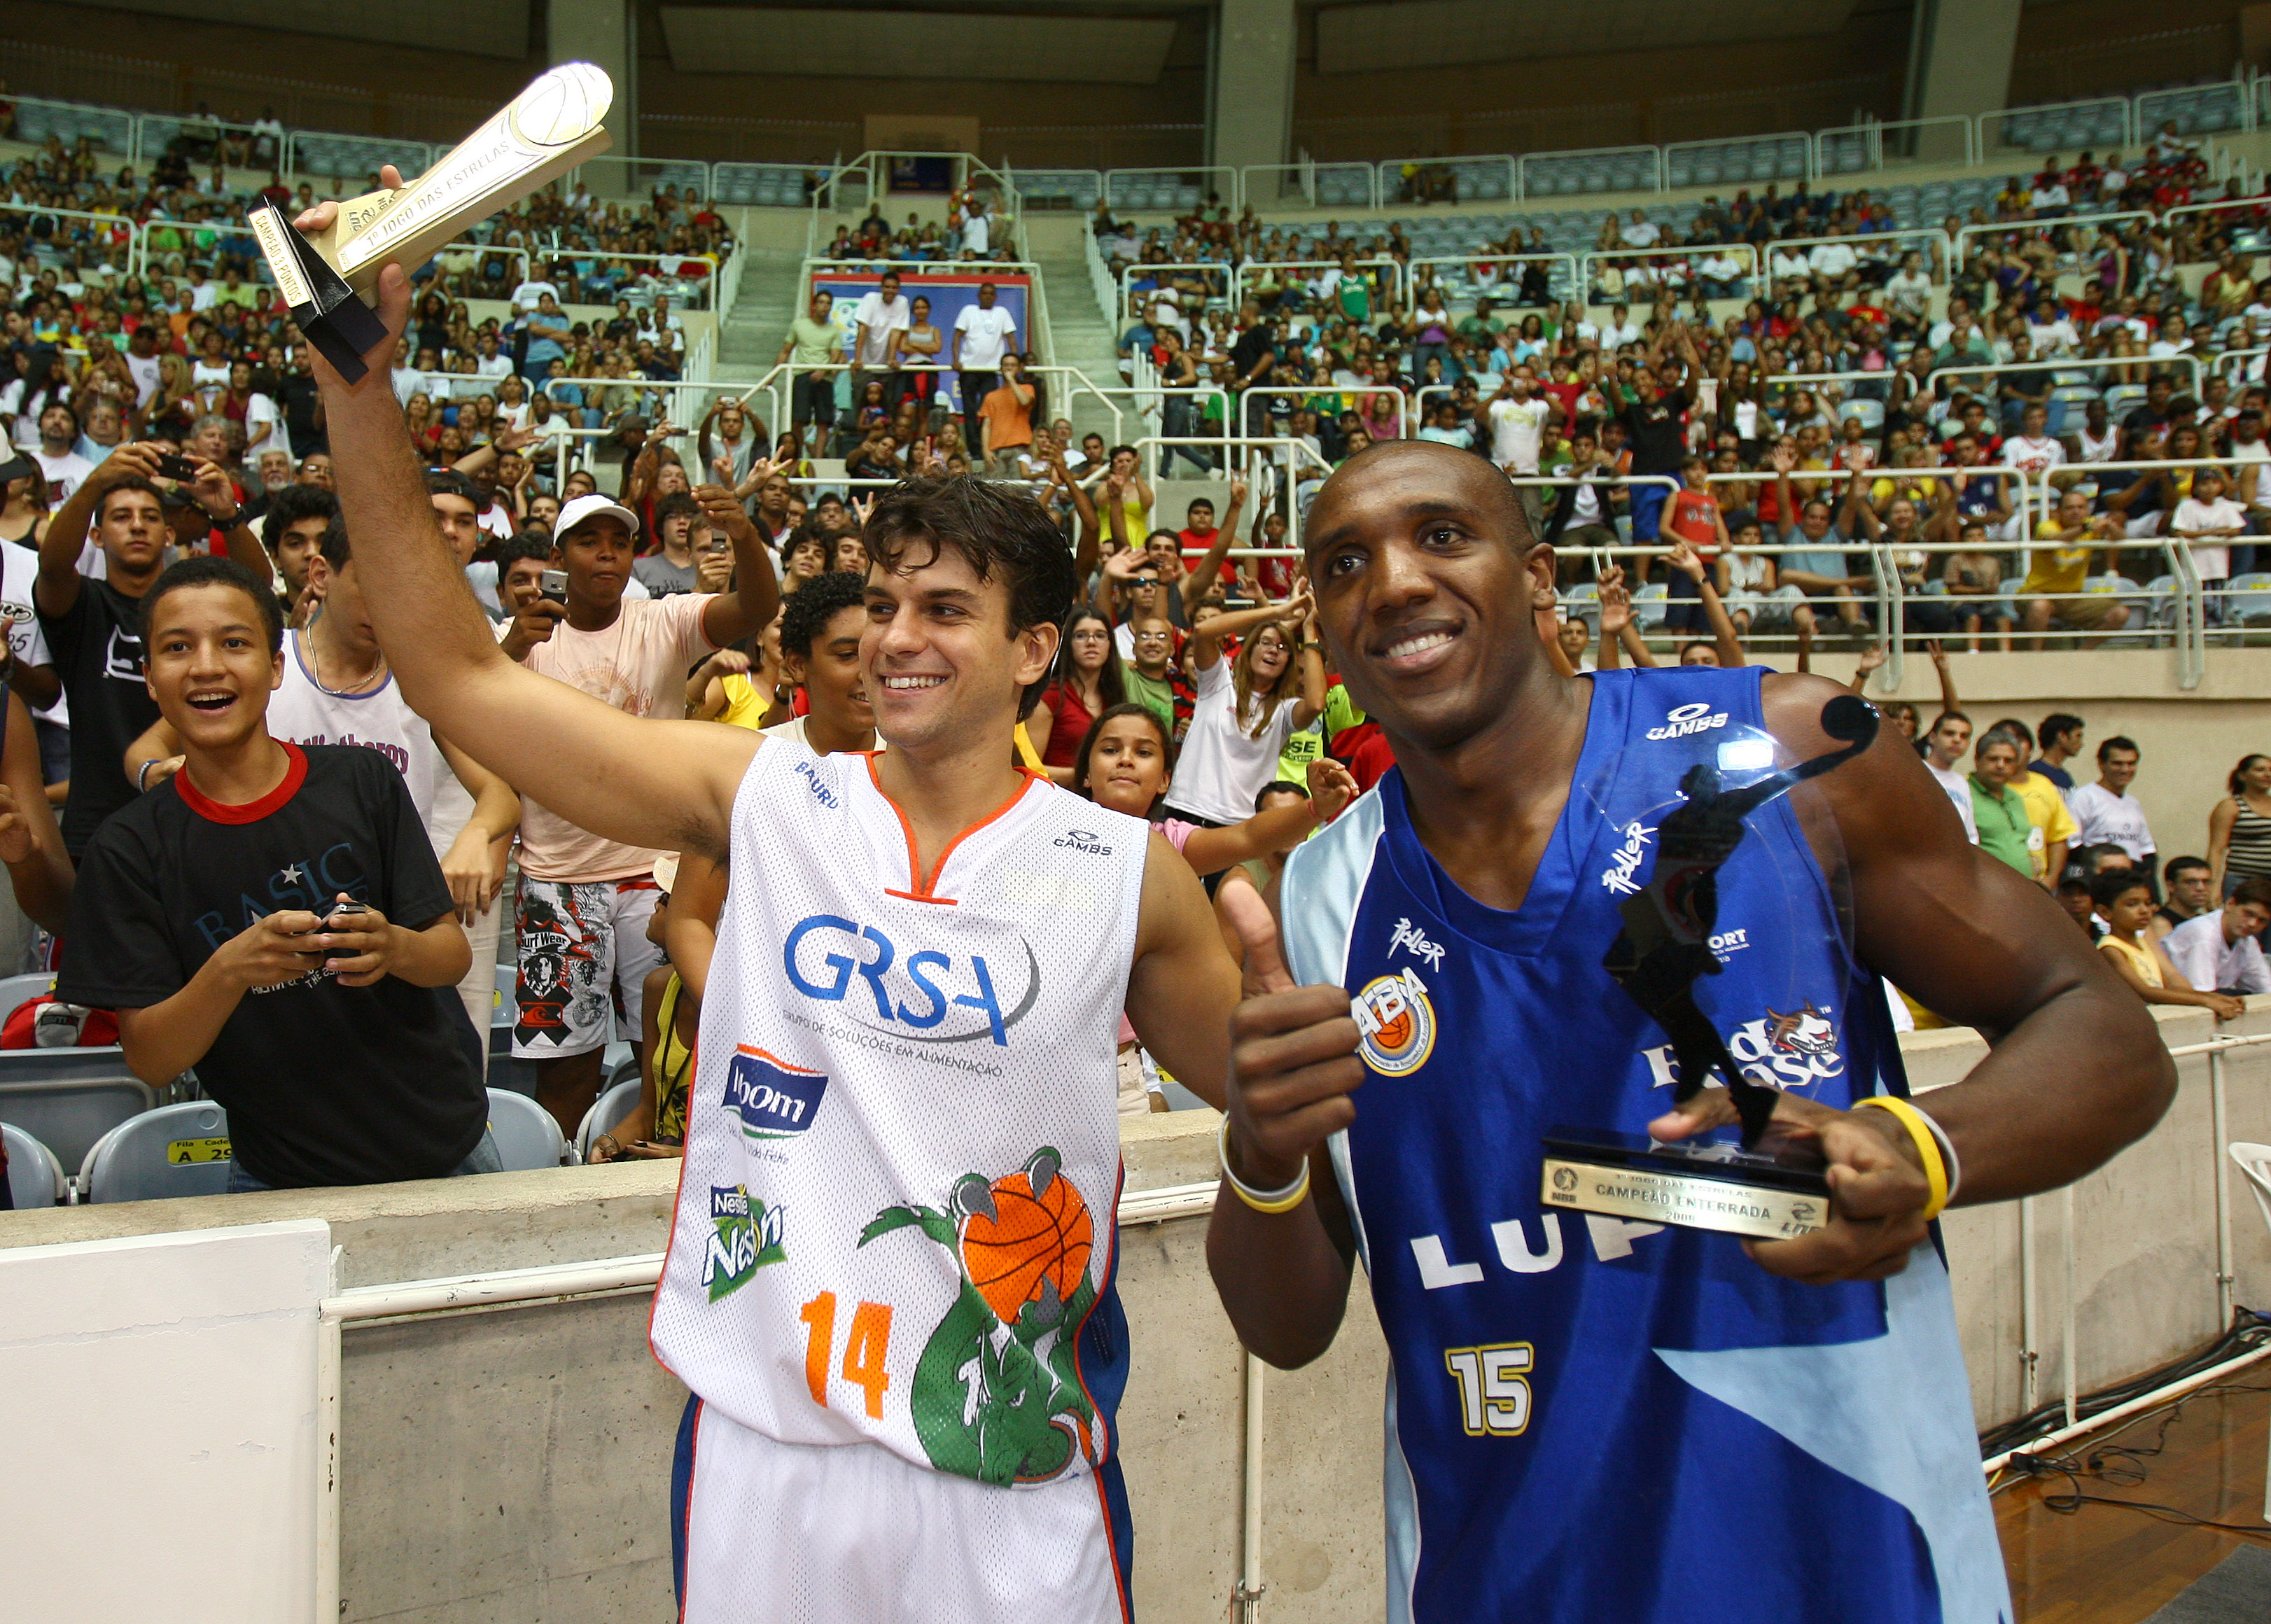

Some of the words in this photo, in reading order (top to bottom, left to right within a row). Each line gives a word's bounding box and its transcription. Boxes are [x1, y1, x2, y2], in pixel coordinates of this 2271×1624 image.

[382, 207, 414, 236] JOGO
[417, 187, 444, 211] DAS
[447, 141, 510, 190] ESTRELAS
[255, 215, 282, 258] CAMPEÃO
[274, 256, 286, 266] 3
[277, 265, 302, 302] PONTOS
[795, 762, 839, 809] BAURU
[193, 842, 365, 951] BASIC
[540, 932, 567, 946] Wear
[305, 970, 322, 988] THE
[783, 913, 1008, 1047] GRSA
[1350, 966, 1429, 1053] ABA
[812, 1021, 825, 1036] DE
[895, 1044, 912, 1058] EM
[178, 1151, 193, 1163] A
[204, 1138, 230, 1147] Cade
[1596, 1184, 1672, 1205] CAMPEÃO
[1677, 1195, 1771, 1219] ENTERRADA
[800, 1289, 893, 1420] 14
[1446, 1341, 1534, 1436] 15
